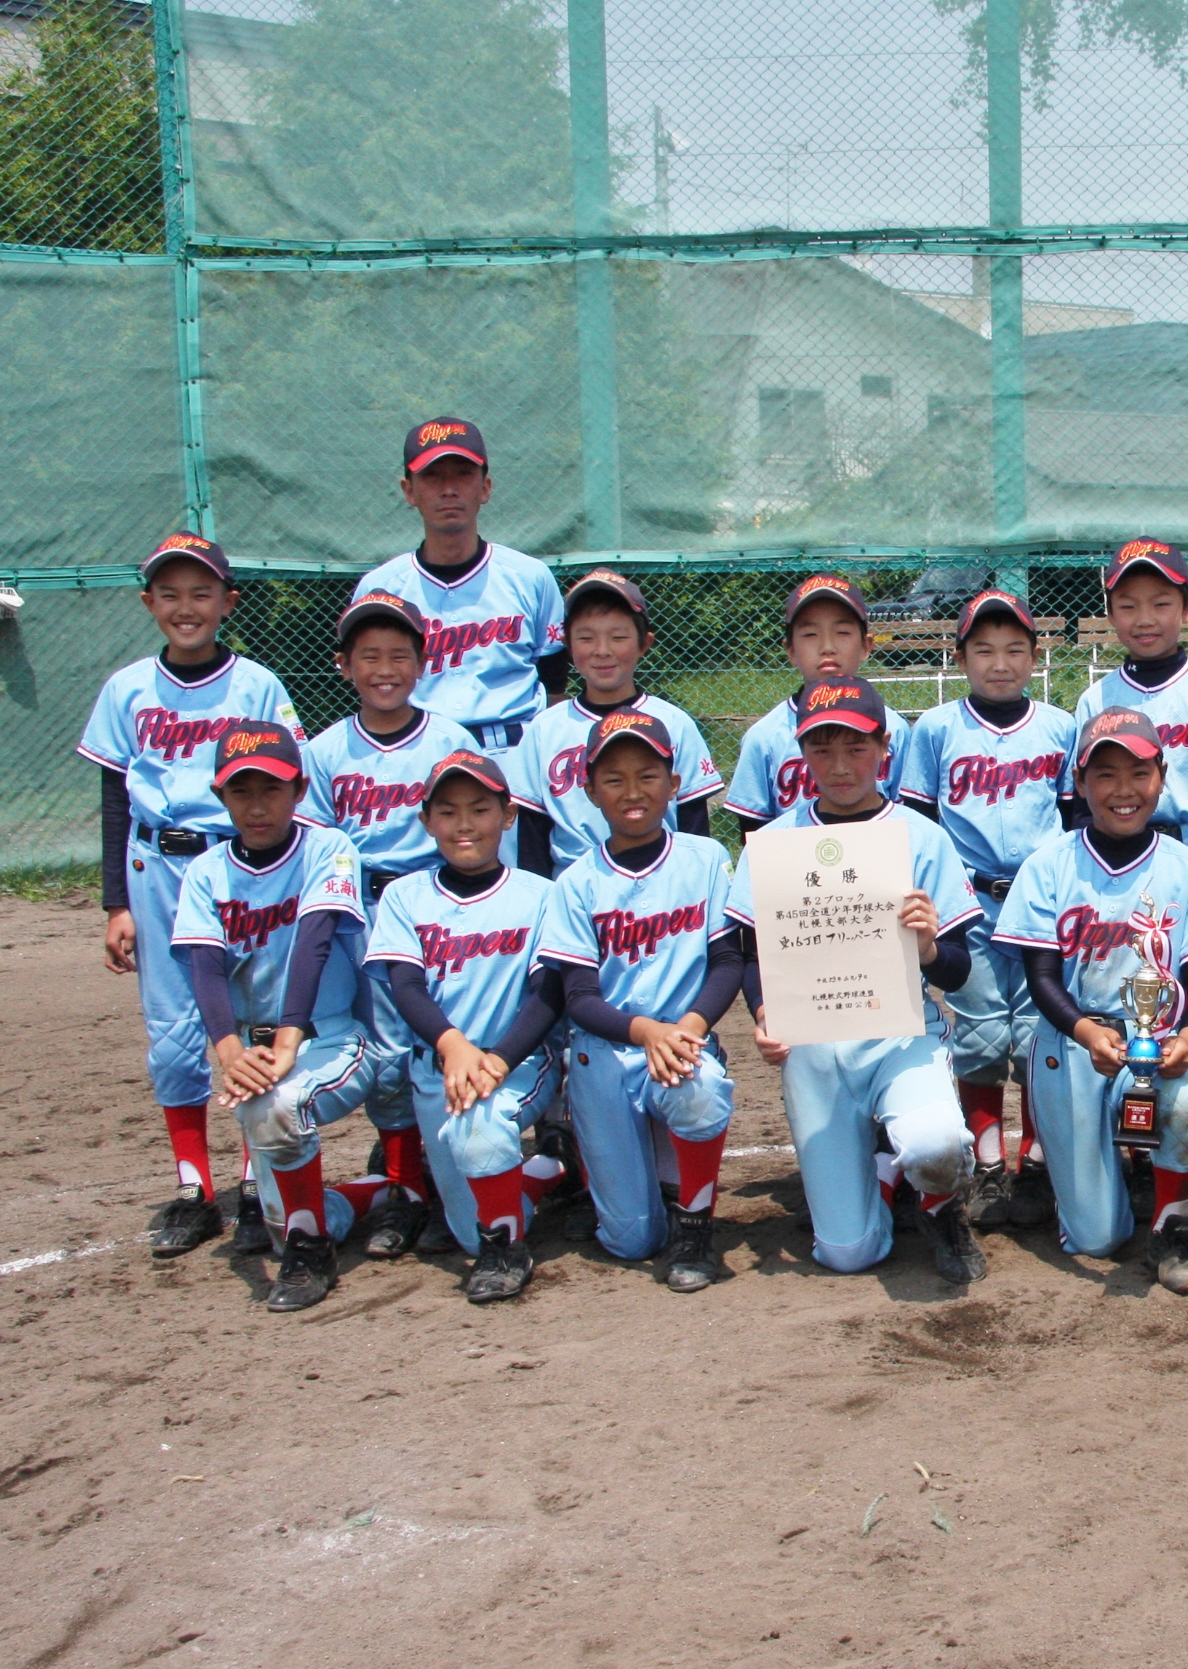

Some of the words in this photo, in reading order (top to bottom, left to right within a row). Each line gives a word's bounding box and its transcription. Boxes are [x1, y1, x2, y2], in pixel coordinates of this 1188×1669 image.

[420, 614, 525, 675] lippers
[949, 751, 1066, 806] Flippers
[414, 923, 531, 979] Flippers
[592, 898, 708, 965] Flippers
